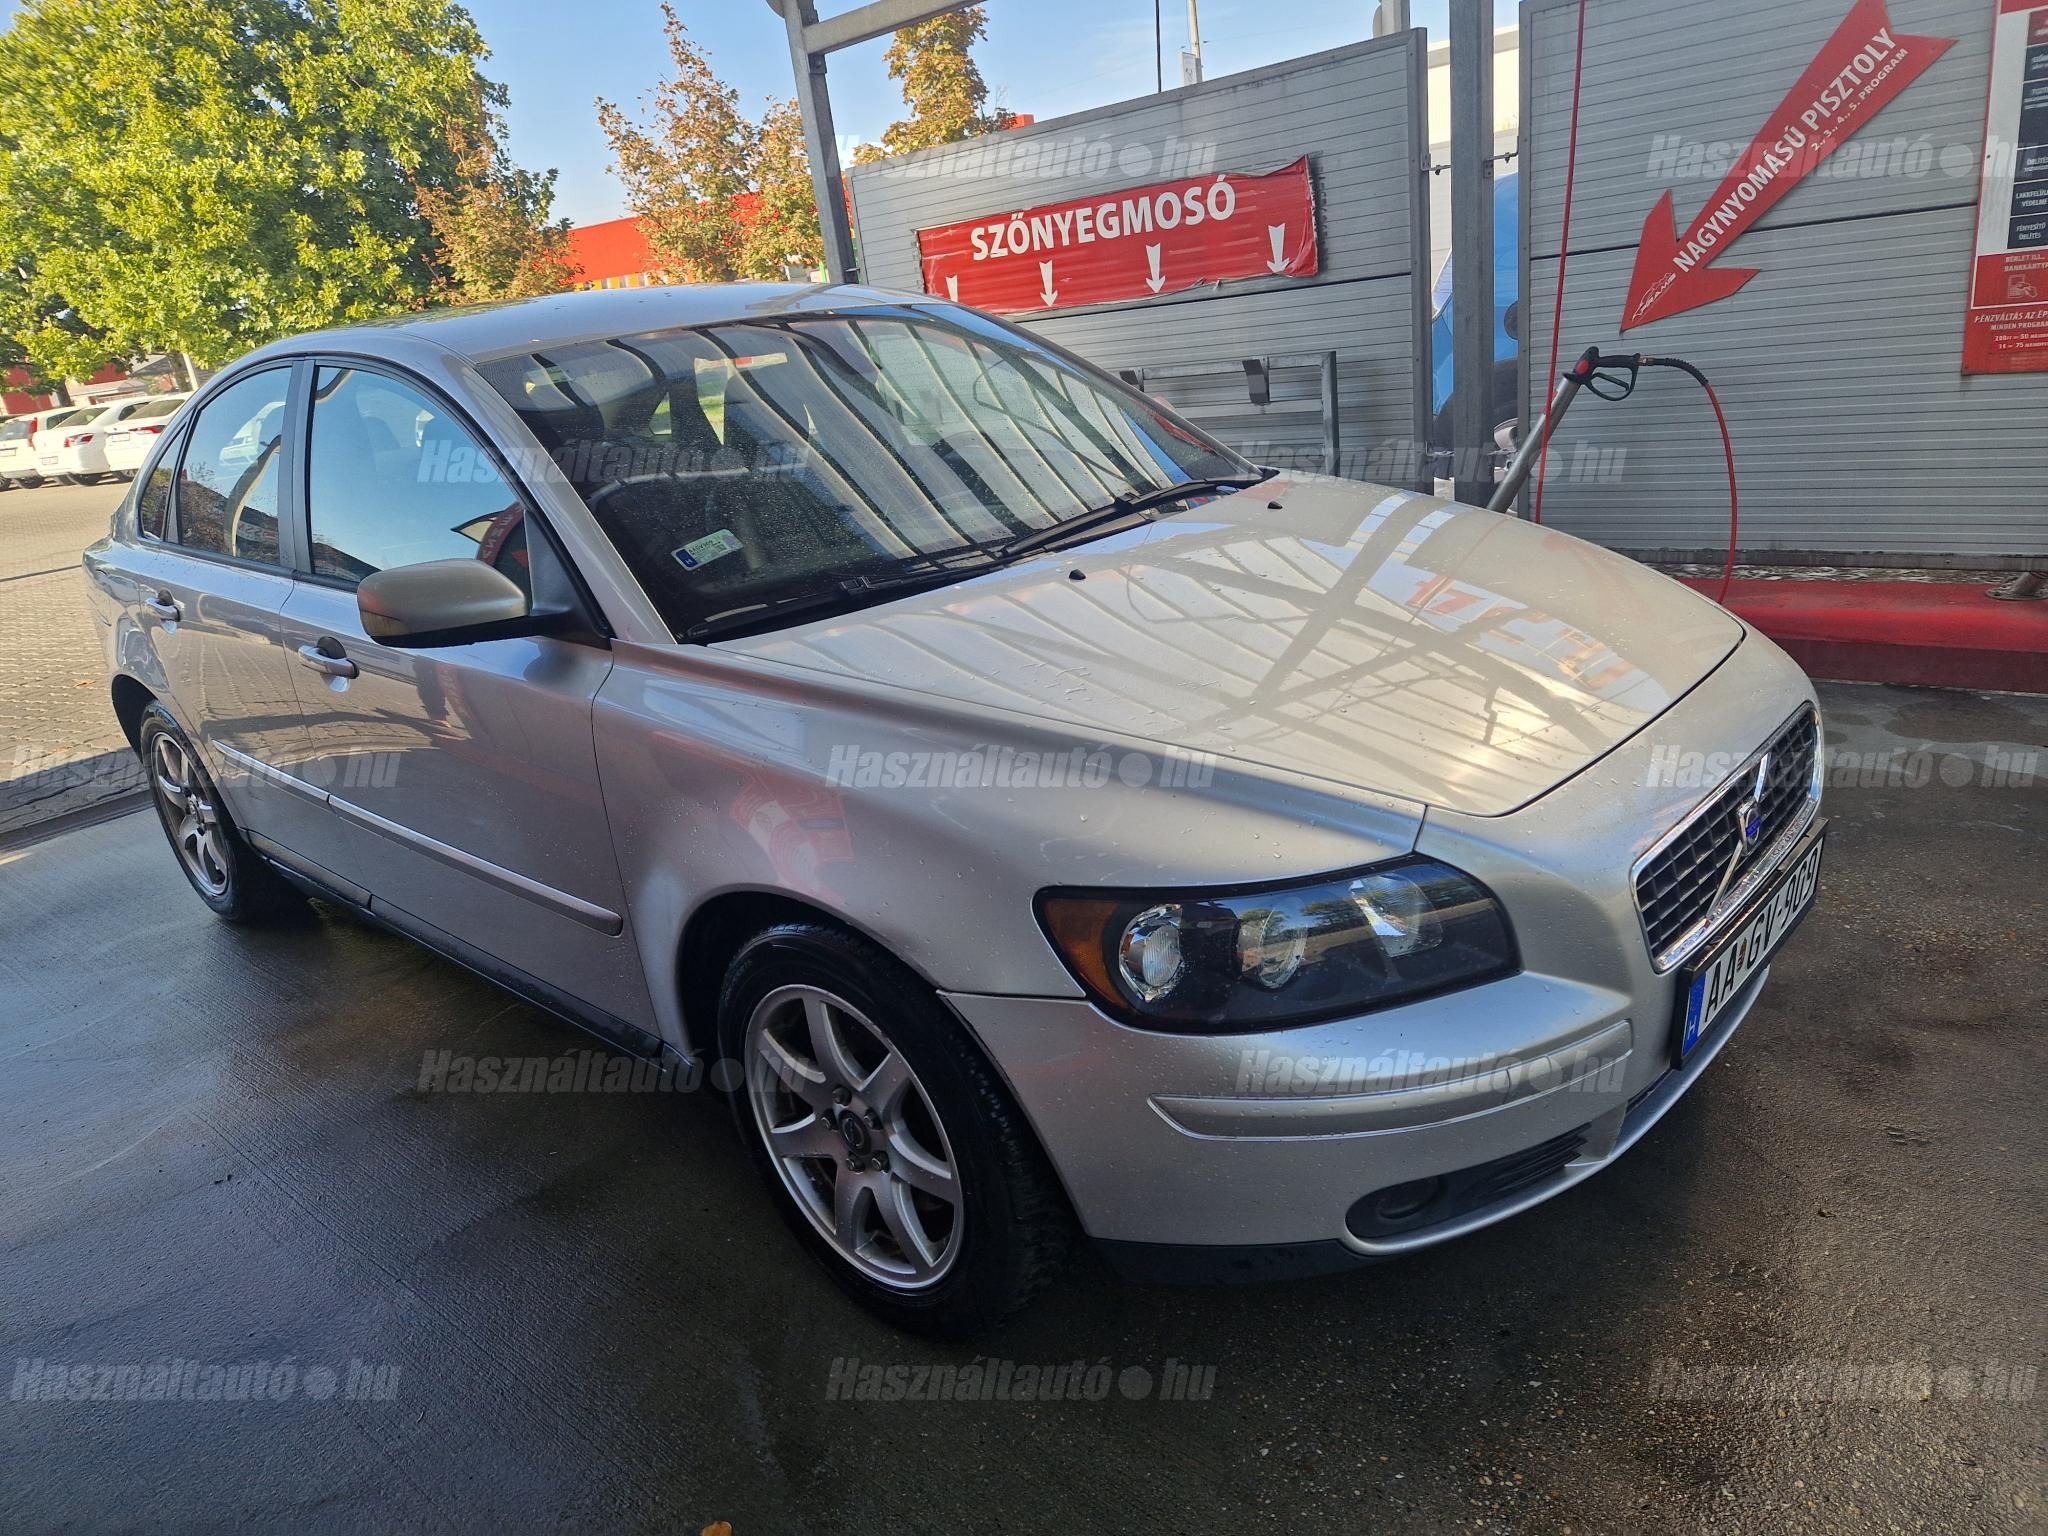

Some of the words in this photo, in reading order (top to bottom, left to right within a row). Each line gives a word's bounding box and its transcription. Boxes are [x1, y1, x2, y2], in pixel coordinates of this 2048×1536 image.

[1858, 48, 1908, 100] PROGRAM
[1673, 125, 1806, 272] NAGYNYOMÁSÚ
[1801, 27, 1897, 131] PISZTOLY
[970, 175, 1236, 262] SZŐNYEGMOSÓ
[1704, 942, 1738, 1022] AA
